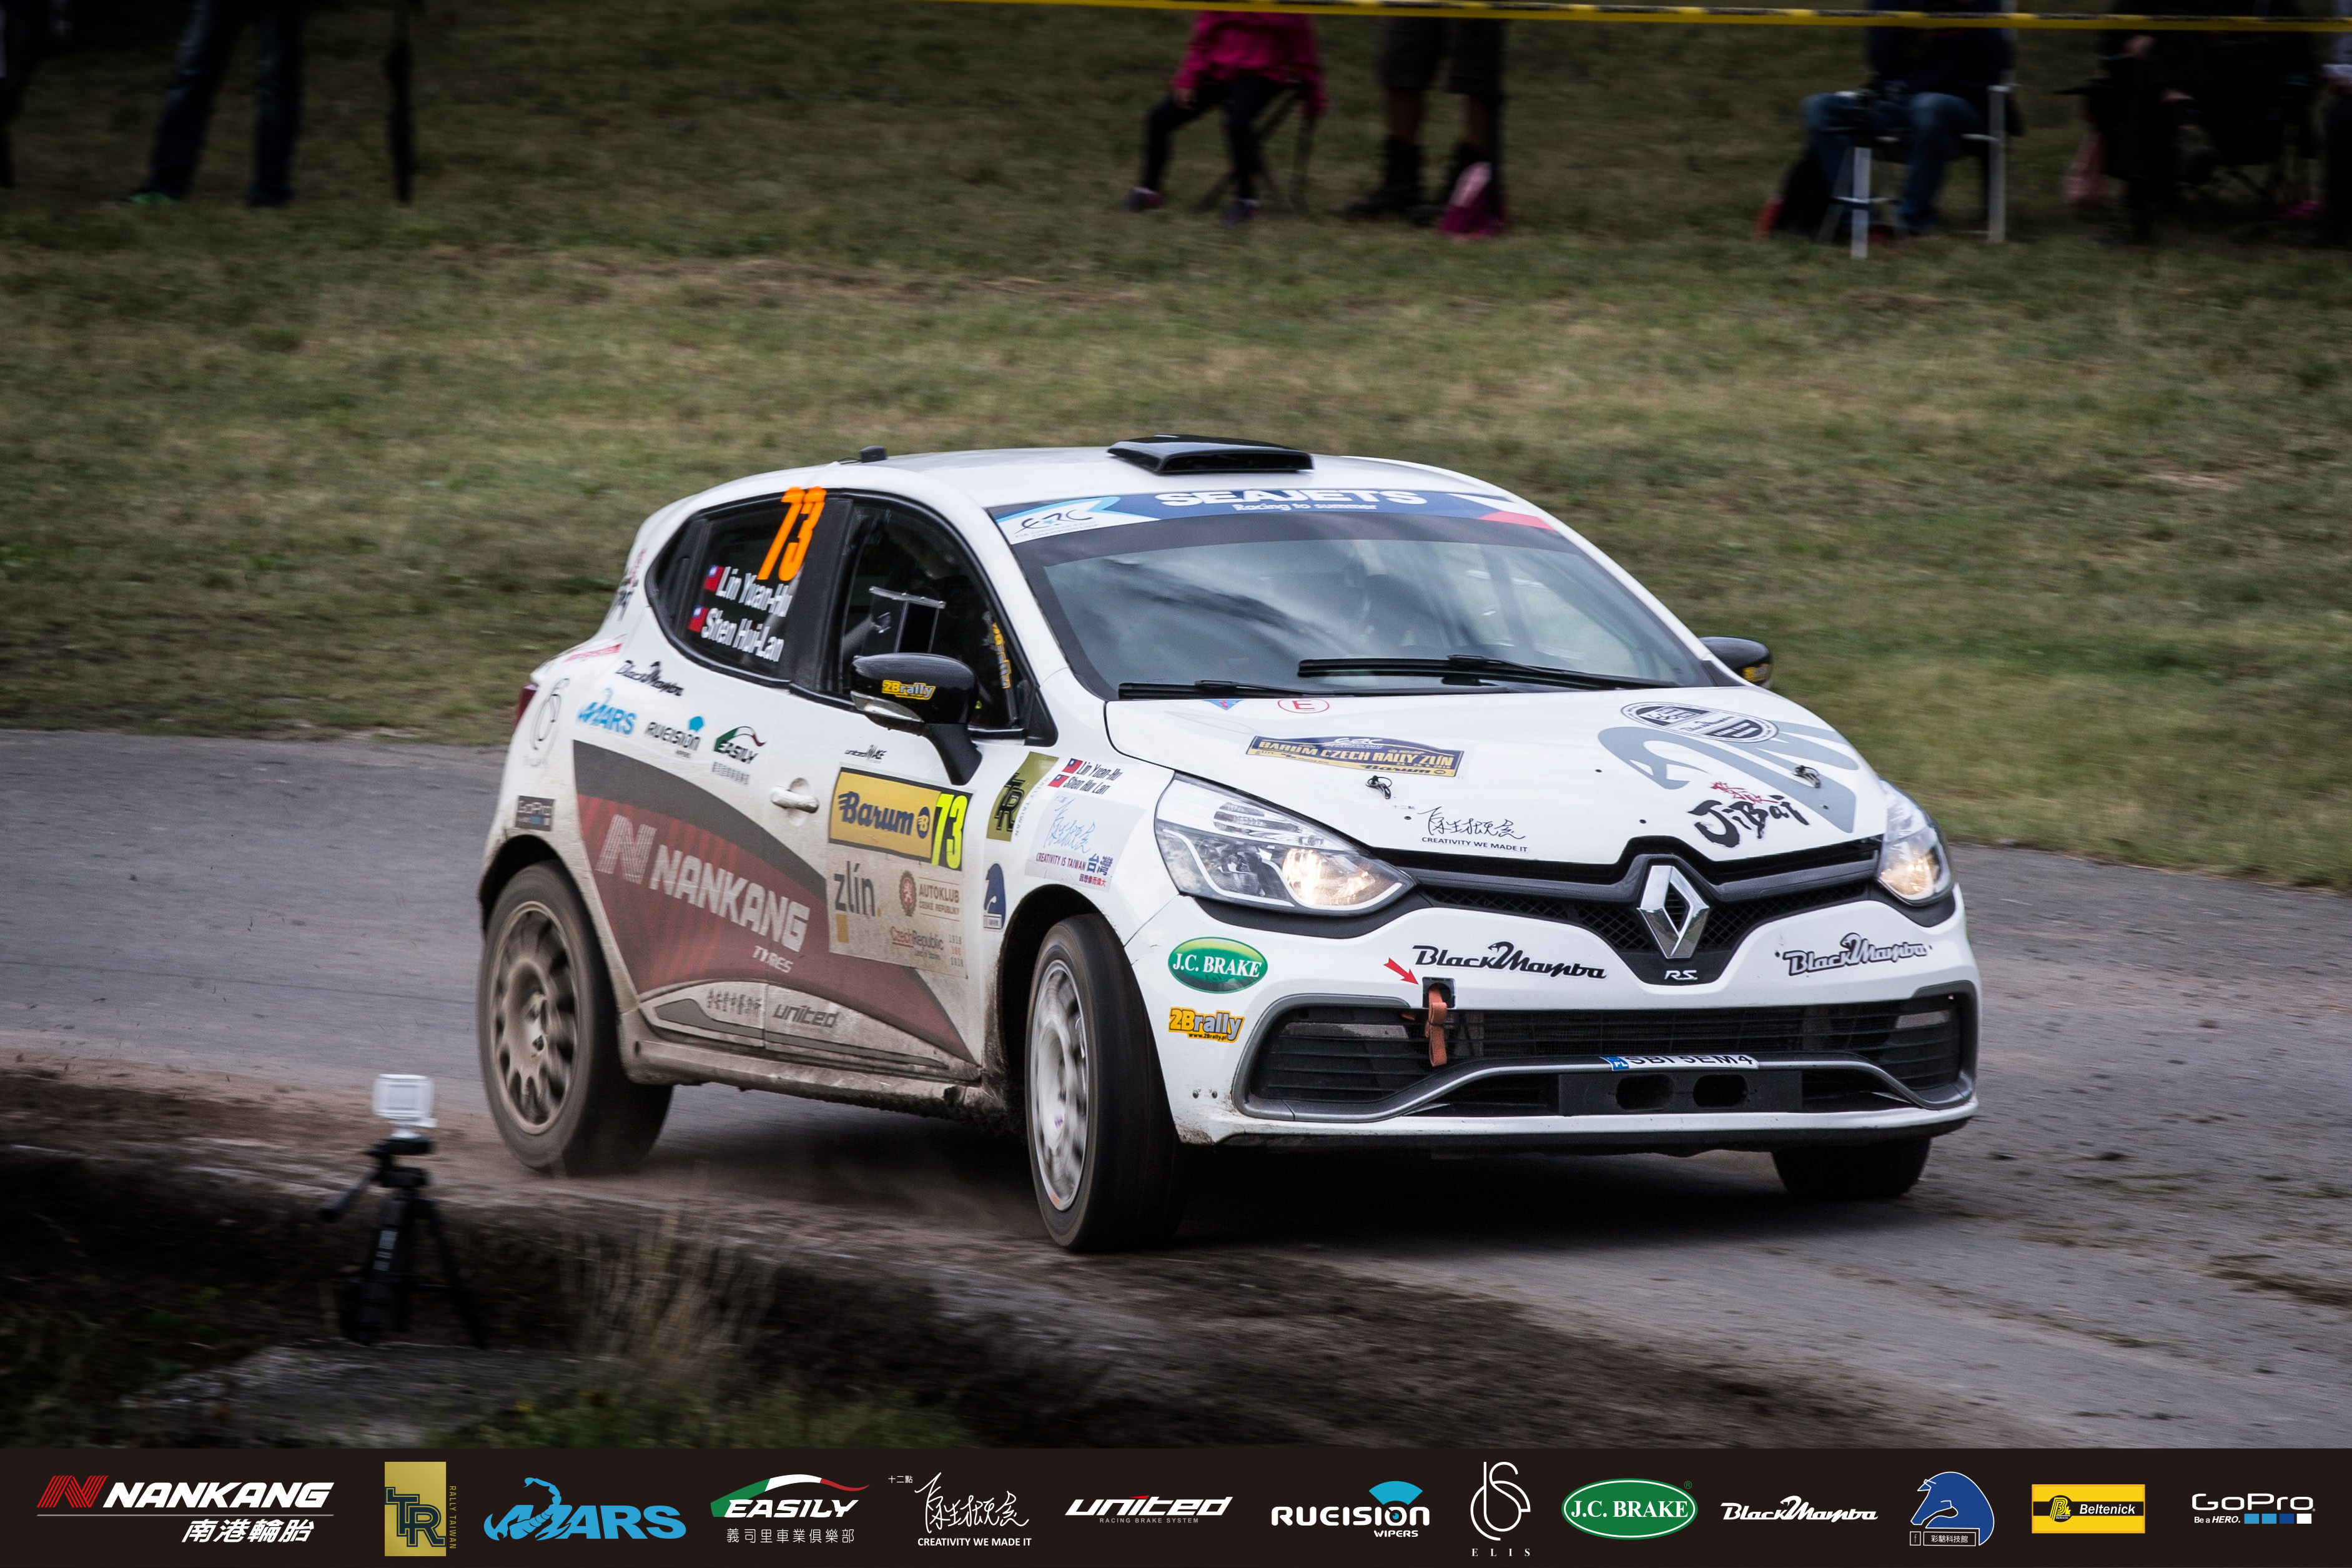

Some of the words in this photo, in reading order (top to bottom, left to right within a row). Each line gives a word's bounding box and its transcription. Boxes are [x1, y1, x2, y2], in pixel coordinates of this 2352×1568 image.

[1155, 489, 1427, 506] SEAJETS
[756, 486, 827, 581] 73
[715, 566, 743, 600] Lin
[701, 608, 738, 646] Shen
[882, 681, 934, 698] 2Brally
[1292, 699, 1316, 710] E
[1258, 741, 1318, 756] BARUM
[1320, 749, 1371, 761] CZECH
[1372, 752, 1419, 764] RALLY
[1076, 761, 1092, 775] Lin
[1088, 764, 1123, 781] Yuan-Hu
[1063, 776, 1085, 790] Shen
[1092, 782, 1110, 795] Lan
[838, 791, 915, 836] Barum
[931, 792, 969, 869] 73
[1421, 837, 1471, 846] CREATIVITY
[1491, 843, 1517, 851] MADE
[1036, 852, 1060, 866] CREATIVITY
[1067, 858, 1087, 871] TAIWAN
[648, 844, 811, 953] NANKANG
[919, 884, 960, 904] AUTOKLUB
[752, 945, 794, 974] TYRES
[1172, 953, 1199, 972] J.C.
[1202, 956, 1263, 978] BRAKE
[773, 1003, 841, 1028] united
[1169, 1008, 1243, 1041] 2Brally
[1188, 1033, 1227, 1041] www.2Brally.pl
